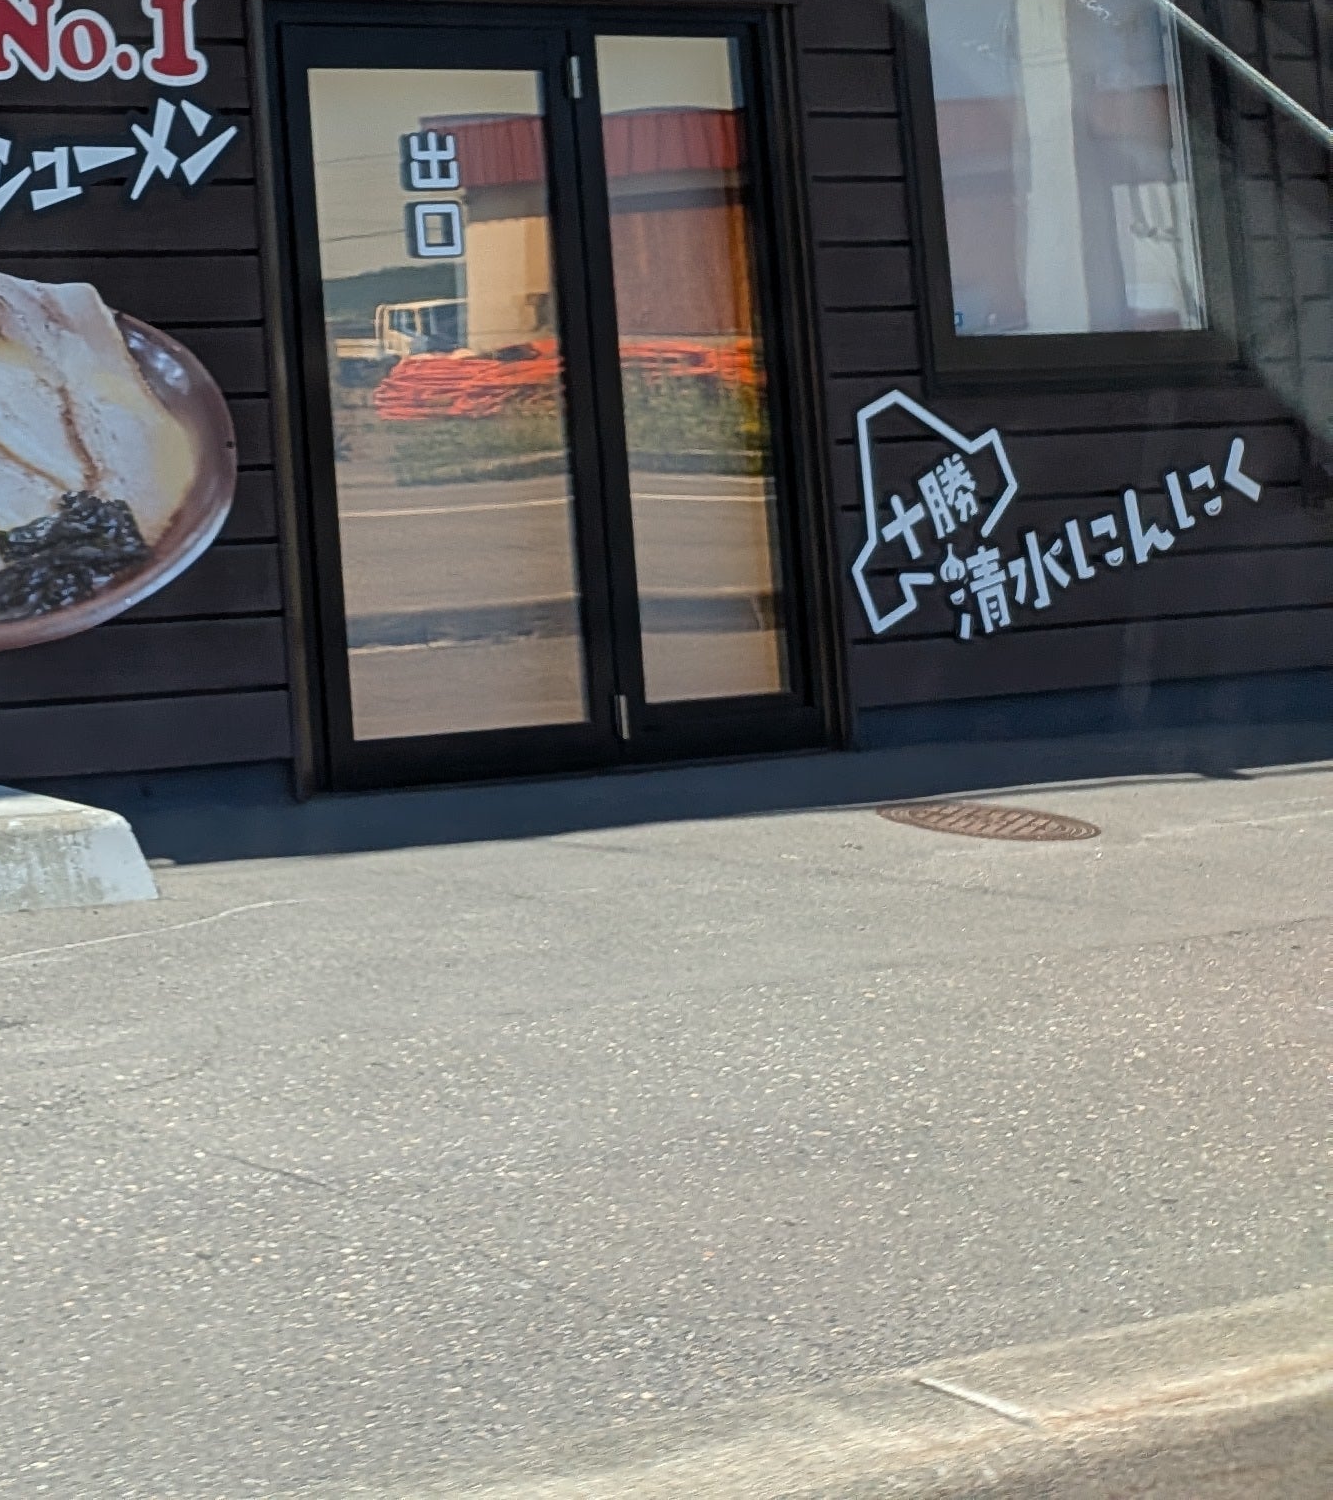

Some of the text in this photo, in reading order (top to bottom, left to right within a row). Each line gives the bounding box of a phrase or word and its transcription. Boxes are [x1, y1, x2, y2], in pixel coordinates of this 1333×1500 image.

[409, 130, 463, 258] 出口
[882, 452, 979, 560] 十勝
[940, 436, 1263, 640] 清水にんにく
